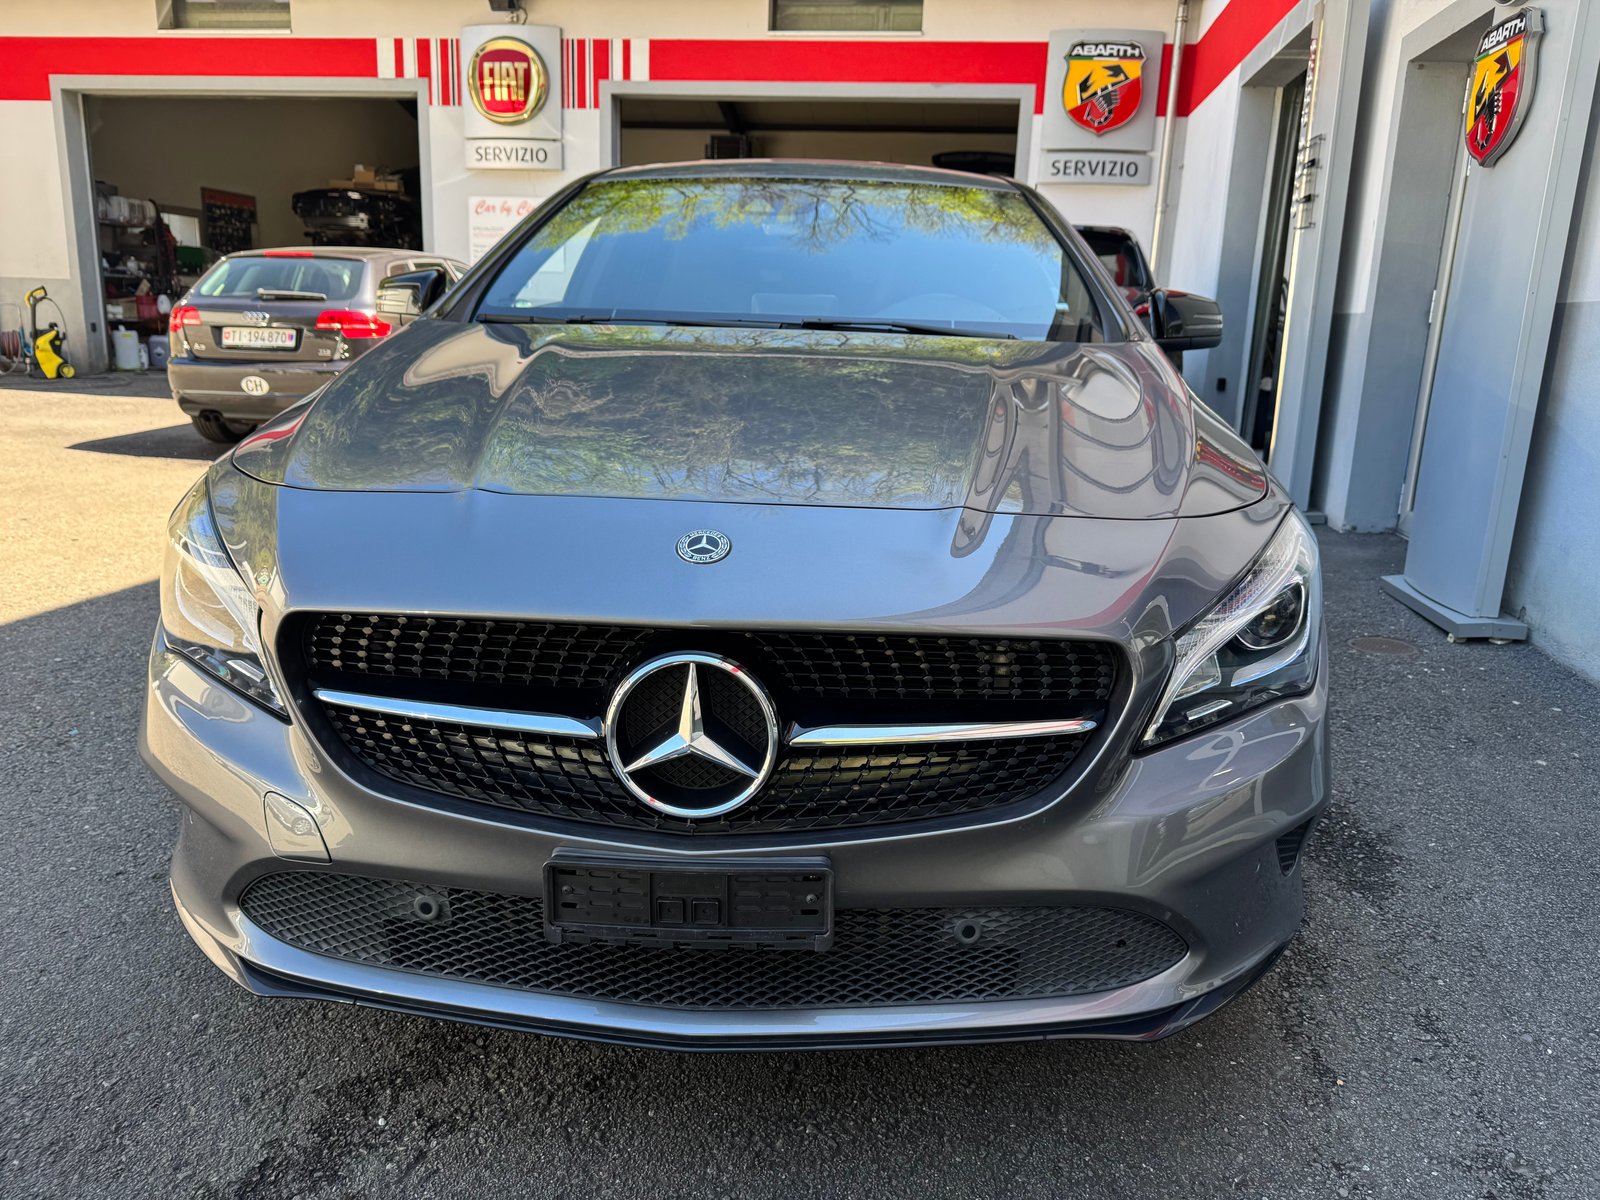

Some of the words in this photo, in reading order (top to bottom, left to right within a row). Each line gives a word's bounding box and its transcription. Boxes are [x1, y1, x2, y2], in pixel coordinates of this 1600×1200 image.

[1480, 17, 1526, 53] ABARTH
[1071, 44, 1140, 57] ABARTH
[482, 61, 528, 101] FIAT
[475, 146, 548, 163] SERVIZIO
[1051, 159, 1139, 177] SERVIZIO
[245, 379, 264, 393] CH
